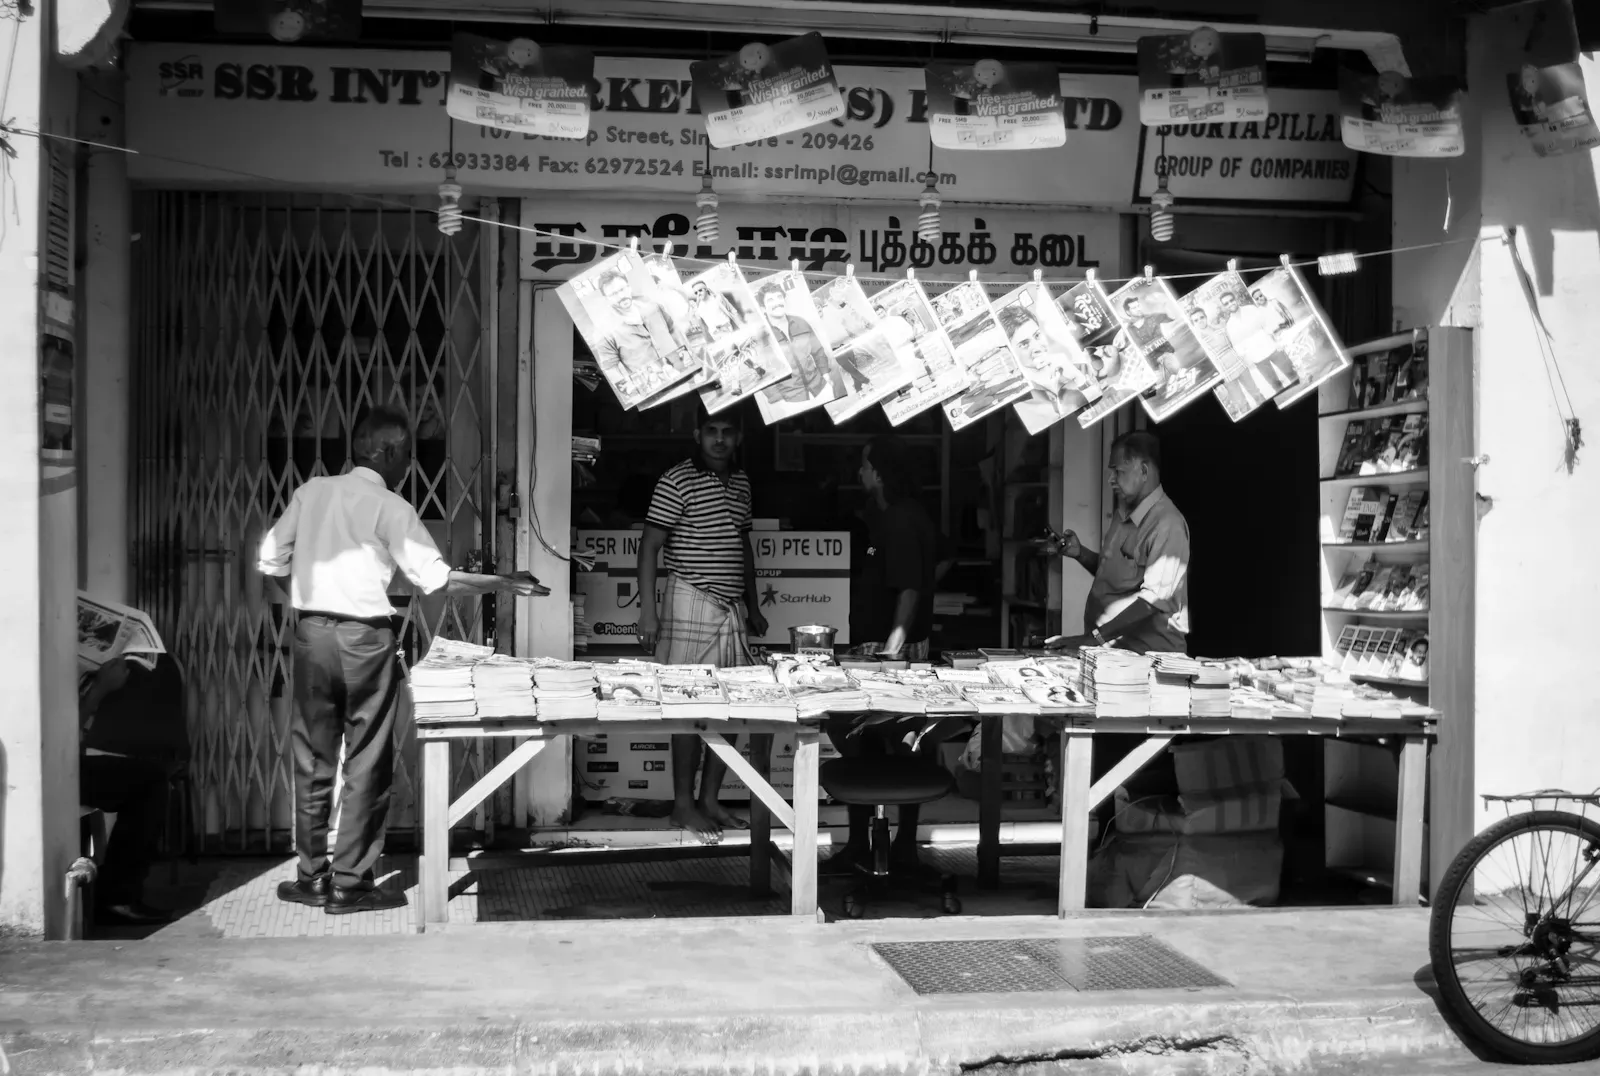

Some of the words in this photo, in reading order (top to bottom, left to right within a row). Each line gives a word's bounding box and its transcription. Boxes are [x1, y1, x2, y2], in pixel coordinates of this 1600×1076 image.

[215, 63, 317, 102] SSR
[502, 83, 533, 97] Wish
[535, 85, 588, 100] granted.
[750, 84, 780, 105] Wish
[780, 64, 830, 97] granted.
[976, 103, 1005, 117] Wish
[1007, 94, 1058, 117] granted.
[606, 126, 674, 145] Street,
[802, 132, 874, 150] 209426
[380, 150, 408, 168] Tel
[429, 151, 530, 171] 62933384
[538, 156, 578, 174] Fax:
[585, 157, 685, 176] 62972524
[1154, 155, 1213, 178] GROUP
[1219, 157, 1243, 178] OF
[1250, 158, 1350, 181] COMPANIES
[1010, 232, 1099, 268] கடை
[585, 537, 616, 555] SSR
[757, 538, 776, 558] (S)
[783, 539, 810, 556] PTE
[816, 539, 842, 556] LTD
[780, 594, 832, 603] StarHub
[604, 623, 638, 635] Phoeni
